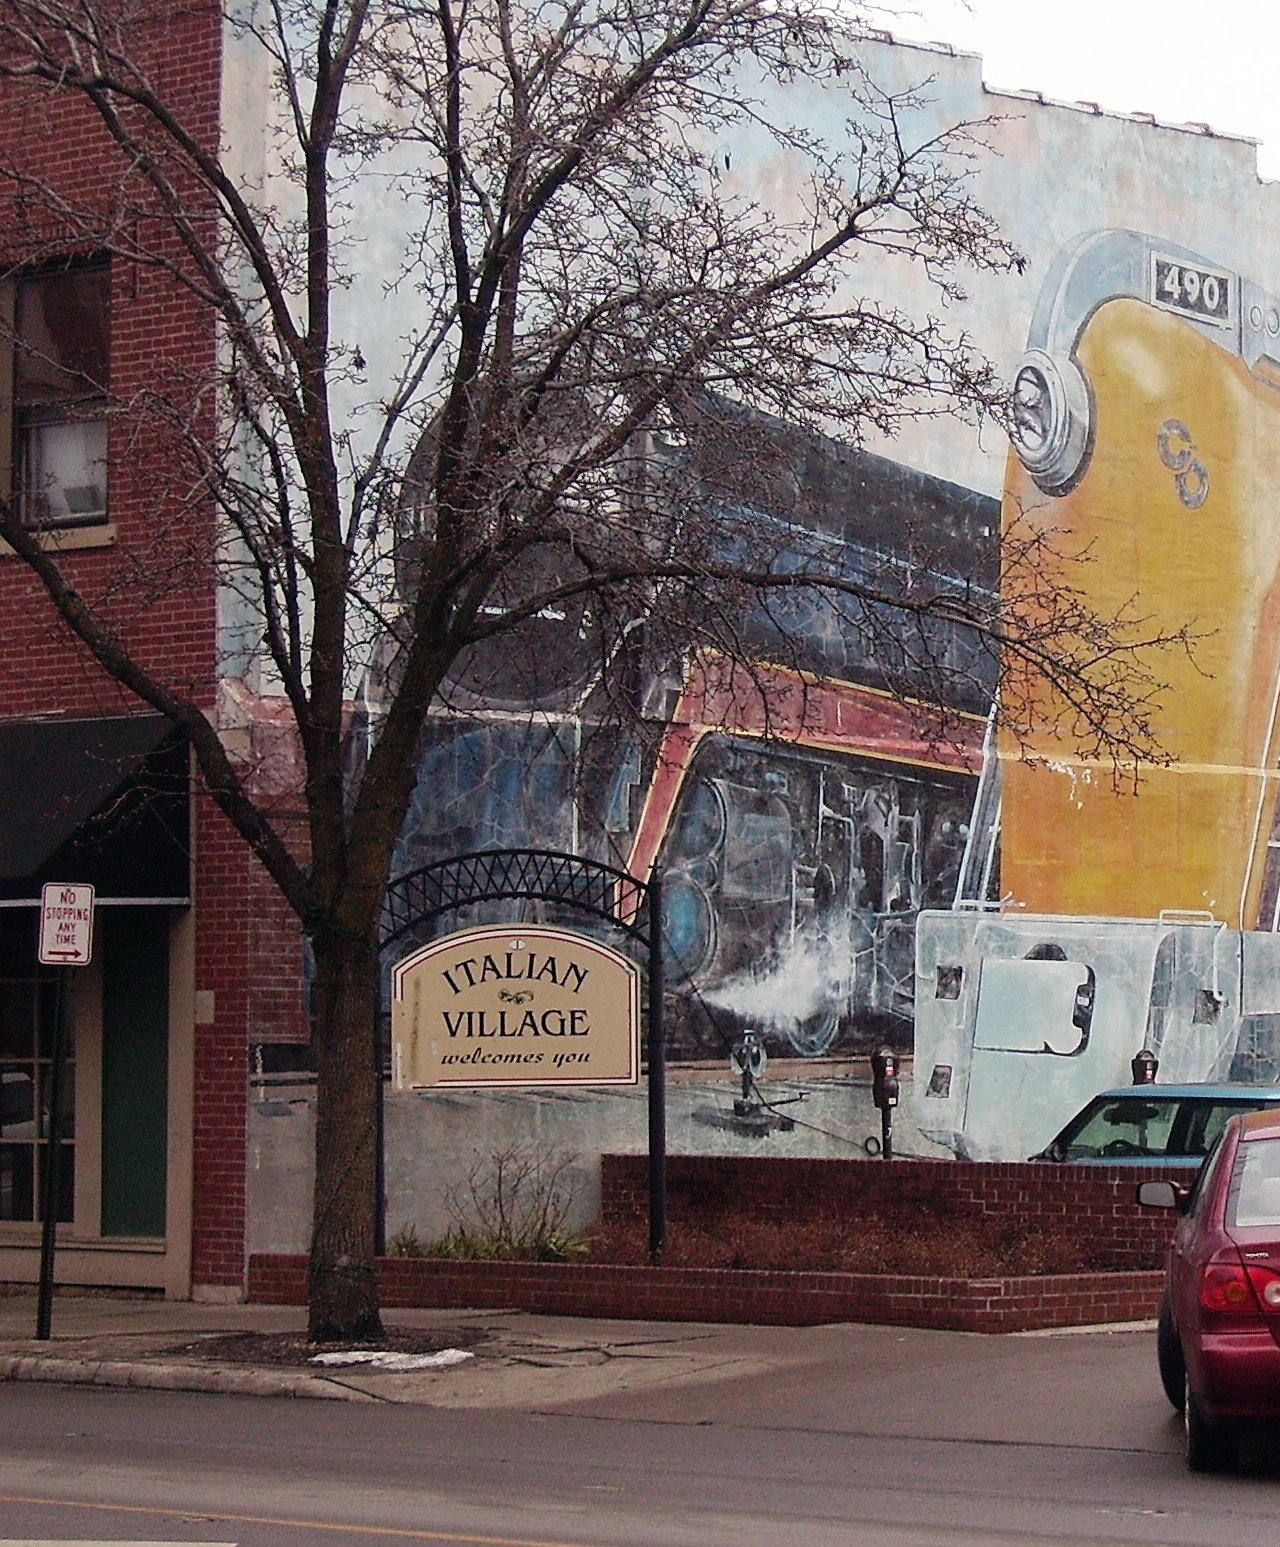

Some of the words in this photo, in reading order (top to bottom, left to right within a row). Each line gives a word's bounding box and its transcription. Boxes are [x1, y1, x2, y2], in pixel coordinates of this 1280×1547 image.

[1164, 265, 1220, 310] 490
[60, 891, 77, 905] NO
[46, 907, 89, 920] STOPPING
[58, 922, 76, 933] ANY
[56, 934, 76, 945] TIME
[441, 952, 589, 995] ITALIAN
[442, 1009, 591, 1038] VILLAGE
[440, 1047, 545, 1065] welcomes
[552, 1052, 591, 1068] you
